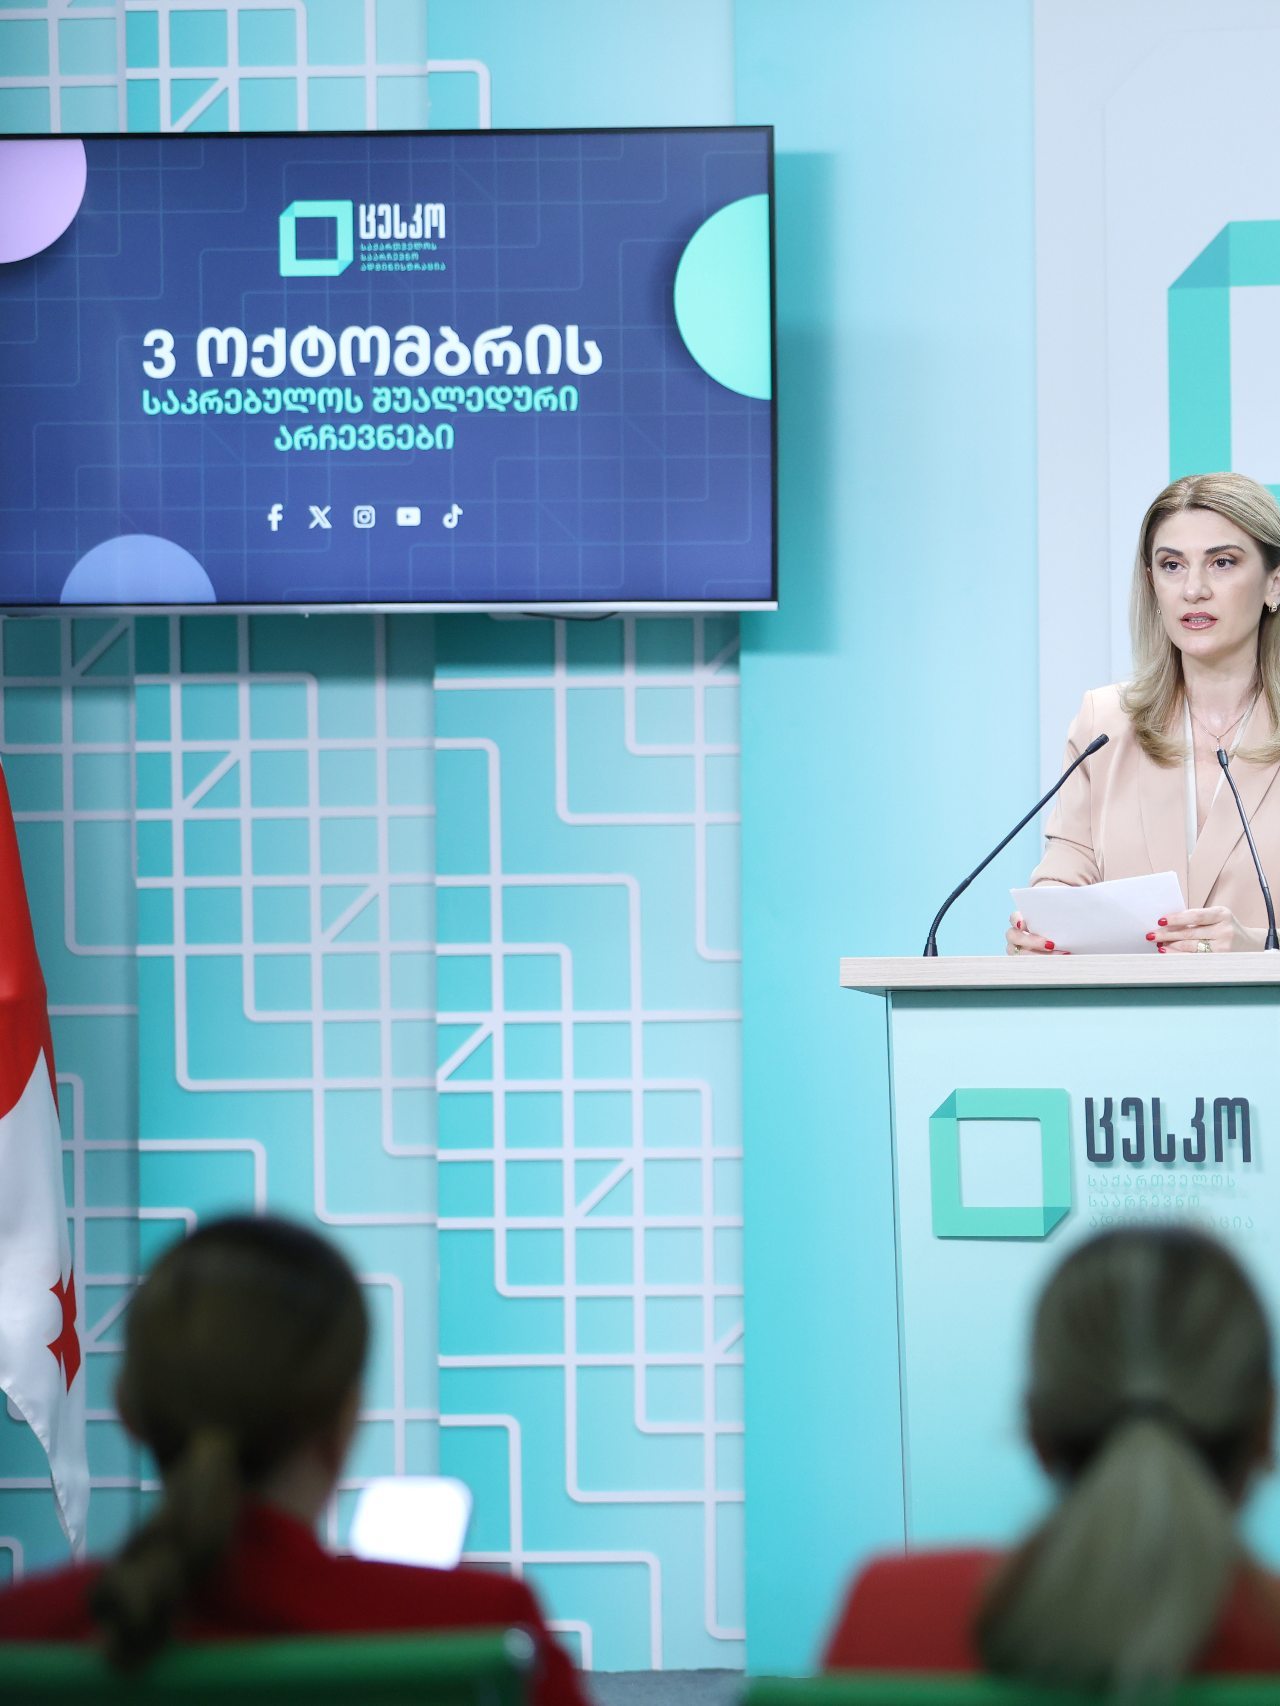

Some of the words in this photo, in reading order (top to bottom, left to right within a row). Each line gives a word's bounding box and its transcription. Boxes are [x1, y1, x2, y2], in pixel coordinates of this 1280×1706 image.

[359, 203, 446, 239] ცესკო
[196, 324, 603, 378] ოქტომბრის
[142, 386, 364, 416] საკრებულოს
[371, 385, 579, 414] შუალედური
[273, 423, 455, 452] არჩევნები
[1084, 1096, 1252, 1163] ცესკო
[1087, 1174, 1236, 1188] საქართველოს
[1088, 1194, 1200, 1209] საარჩევნო
